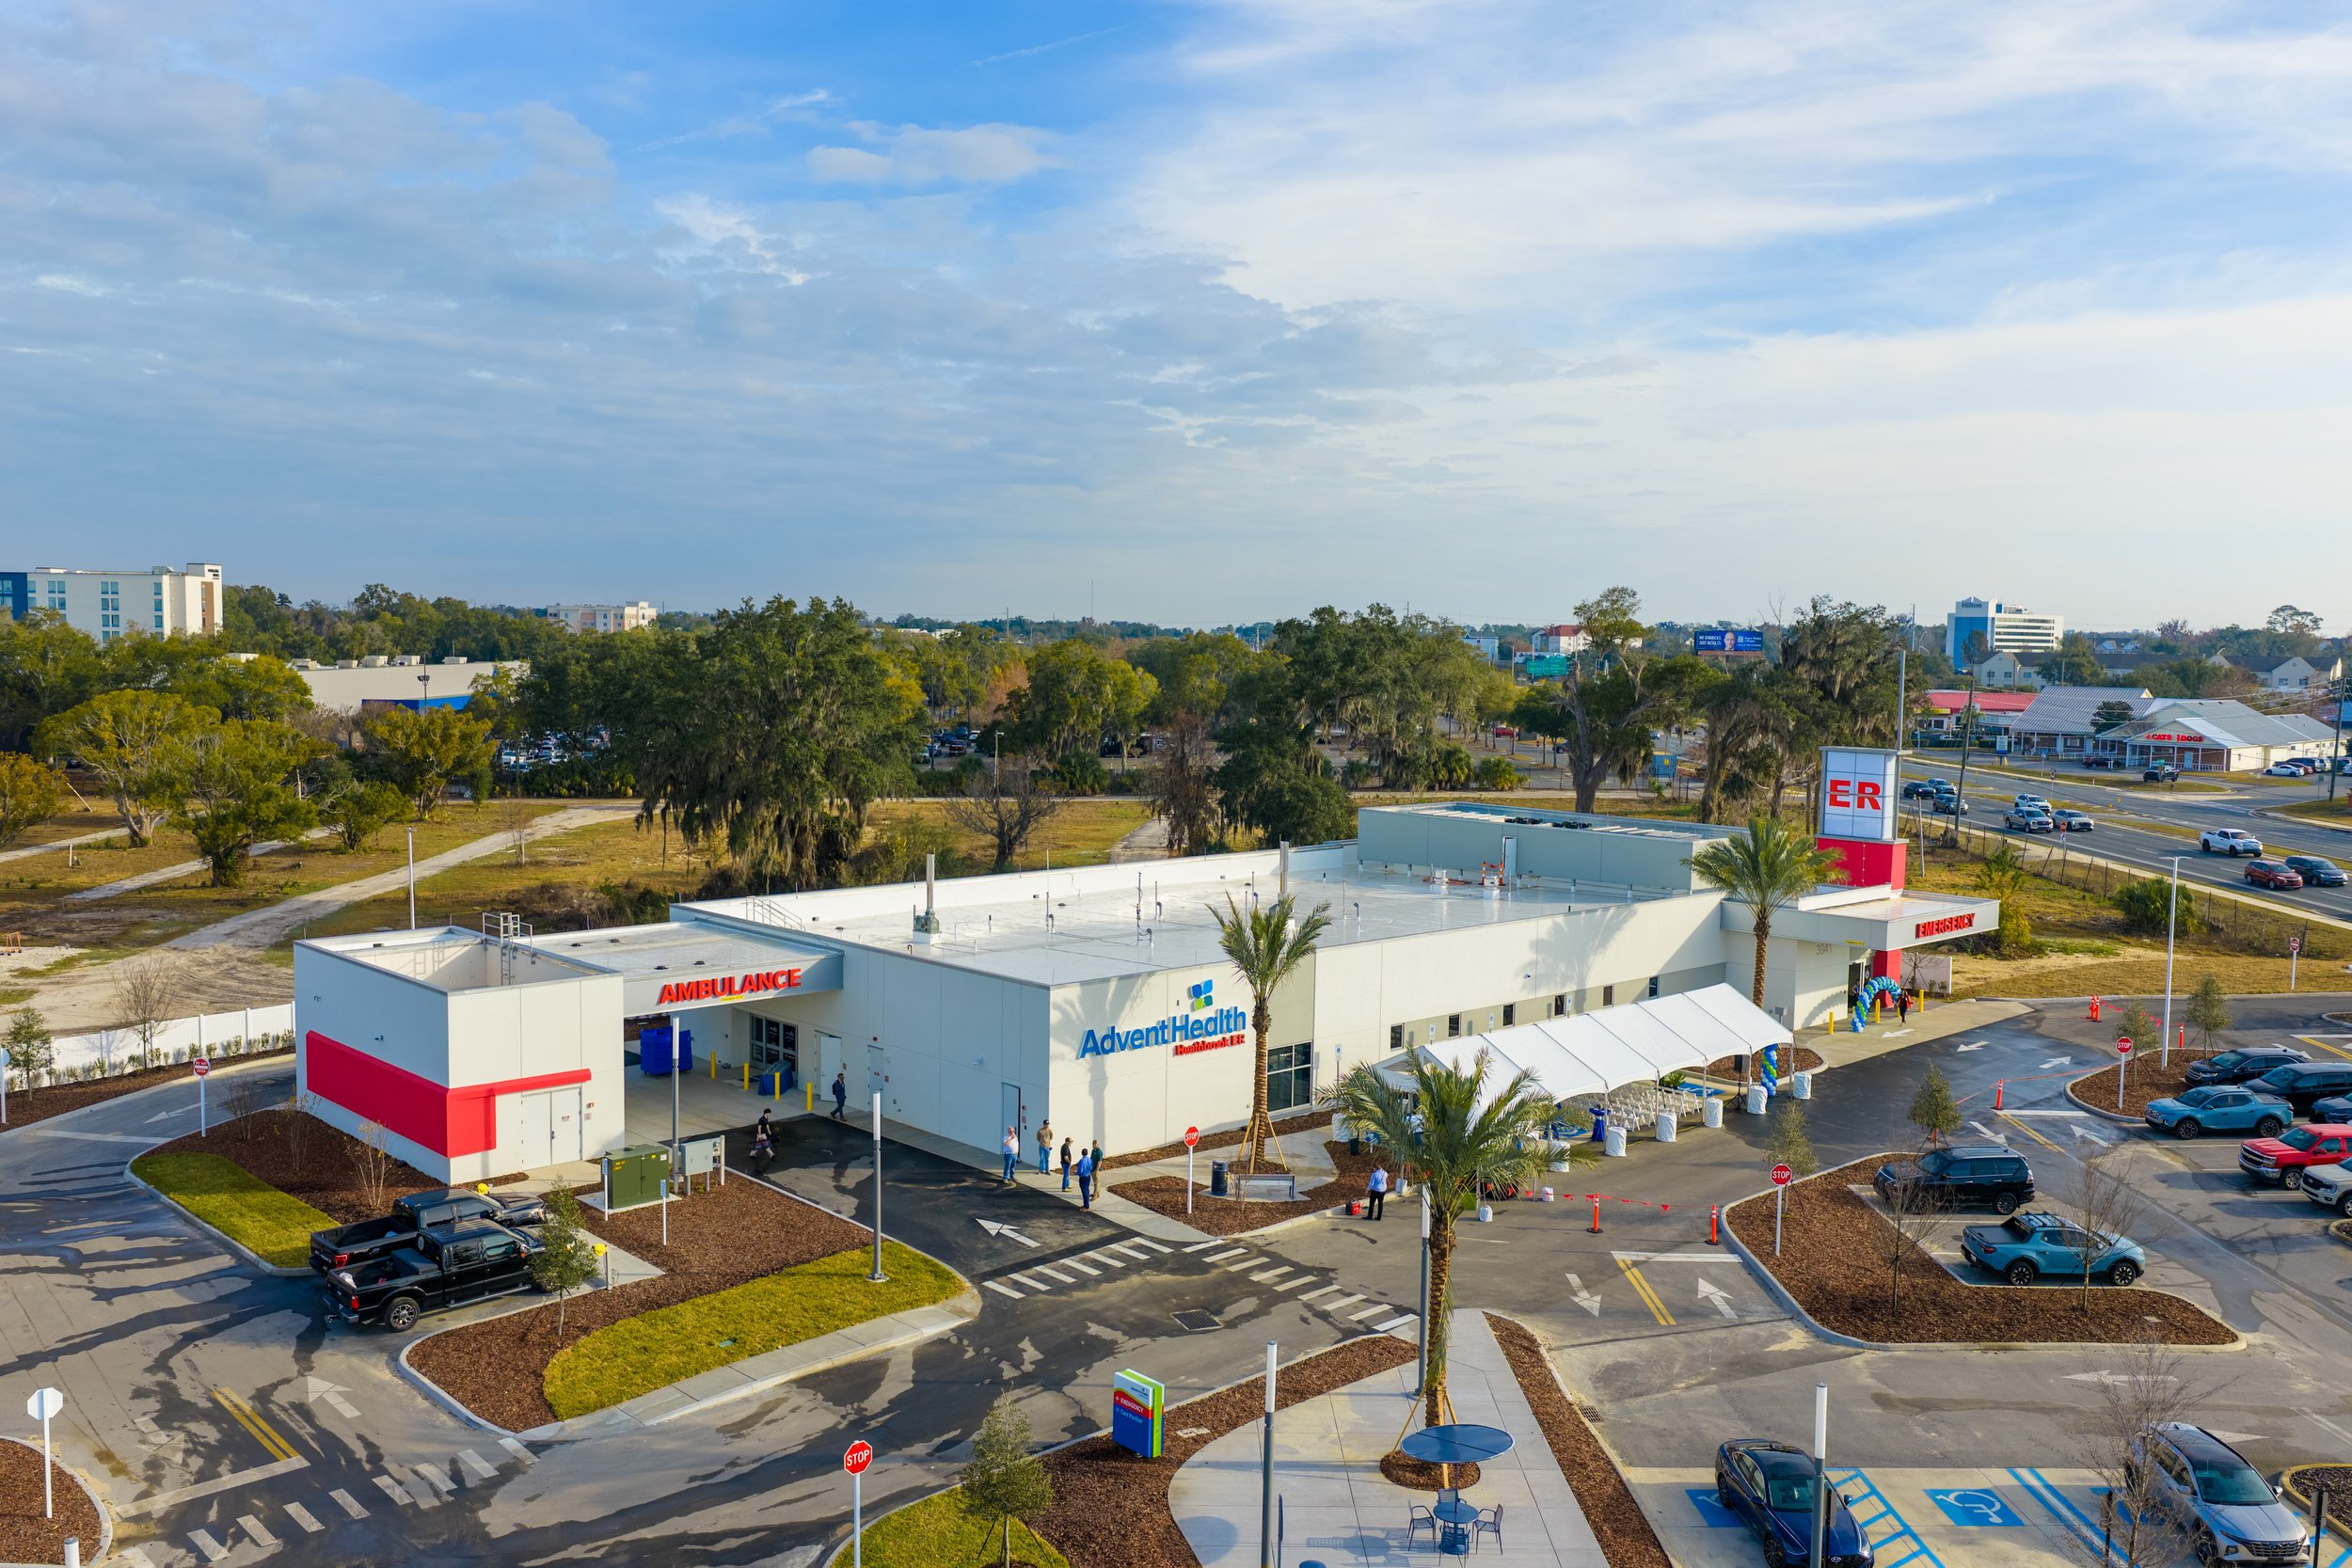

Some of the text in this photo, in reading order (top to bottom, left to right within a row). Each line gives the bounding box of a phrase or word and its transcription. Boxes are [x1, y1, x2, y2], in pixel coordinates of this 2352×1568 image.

[1829, 779, 1882, 810] ER
[1915, 913, 1976, 939] EMERGENCY
[1816, 943, 1833, 956] 3941
[658, 968, 802, 1005] AMBULANCE
[1174, 1034, 1246, 1056] Heathbrook ER
[1185, 1132, 1199, 1142] STOP
[1772, 1171, 1790, 1180] STOP
[1120, 1397, 1144, 1413] EMERGENCY
[847, 1449, 870, 1466] STOP
